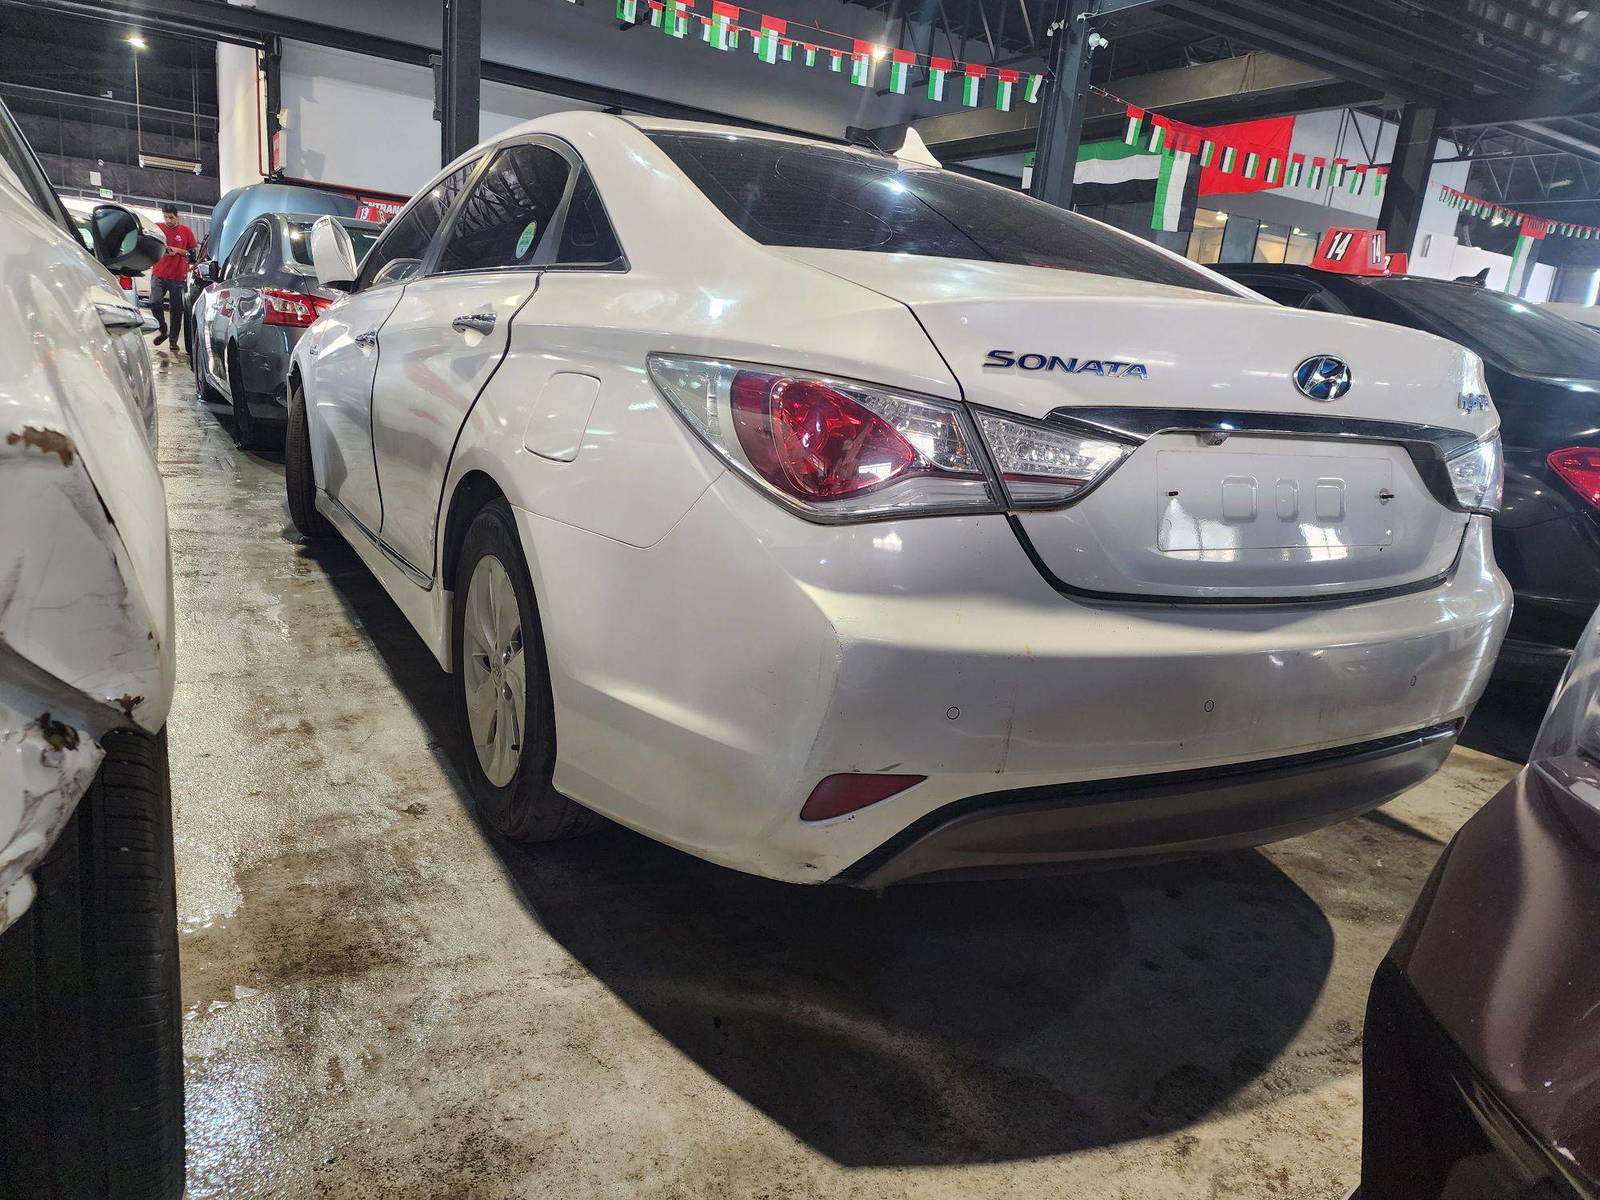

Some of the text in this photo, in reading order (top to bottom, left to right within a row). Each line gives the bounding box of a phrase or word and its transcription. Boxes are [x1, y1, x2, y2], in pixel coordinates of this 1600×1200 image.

[362, 201, 404, 215] NTRAN
[1325, 231, 1354, 262] 14
[982, 349, 1149, 381] SONATA
